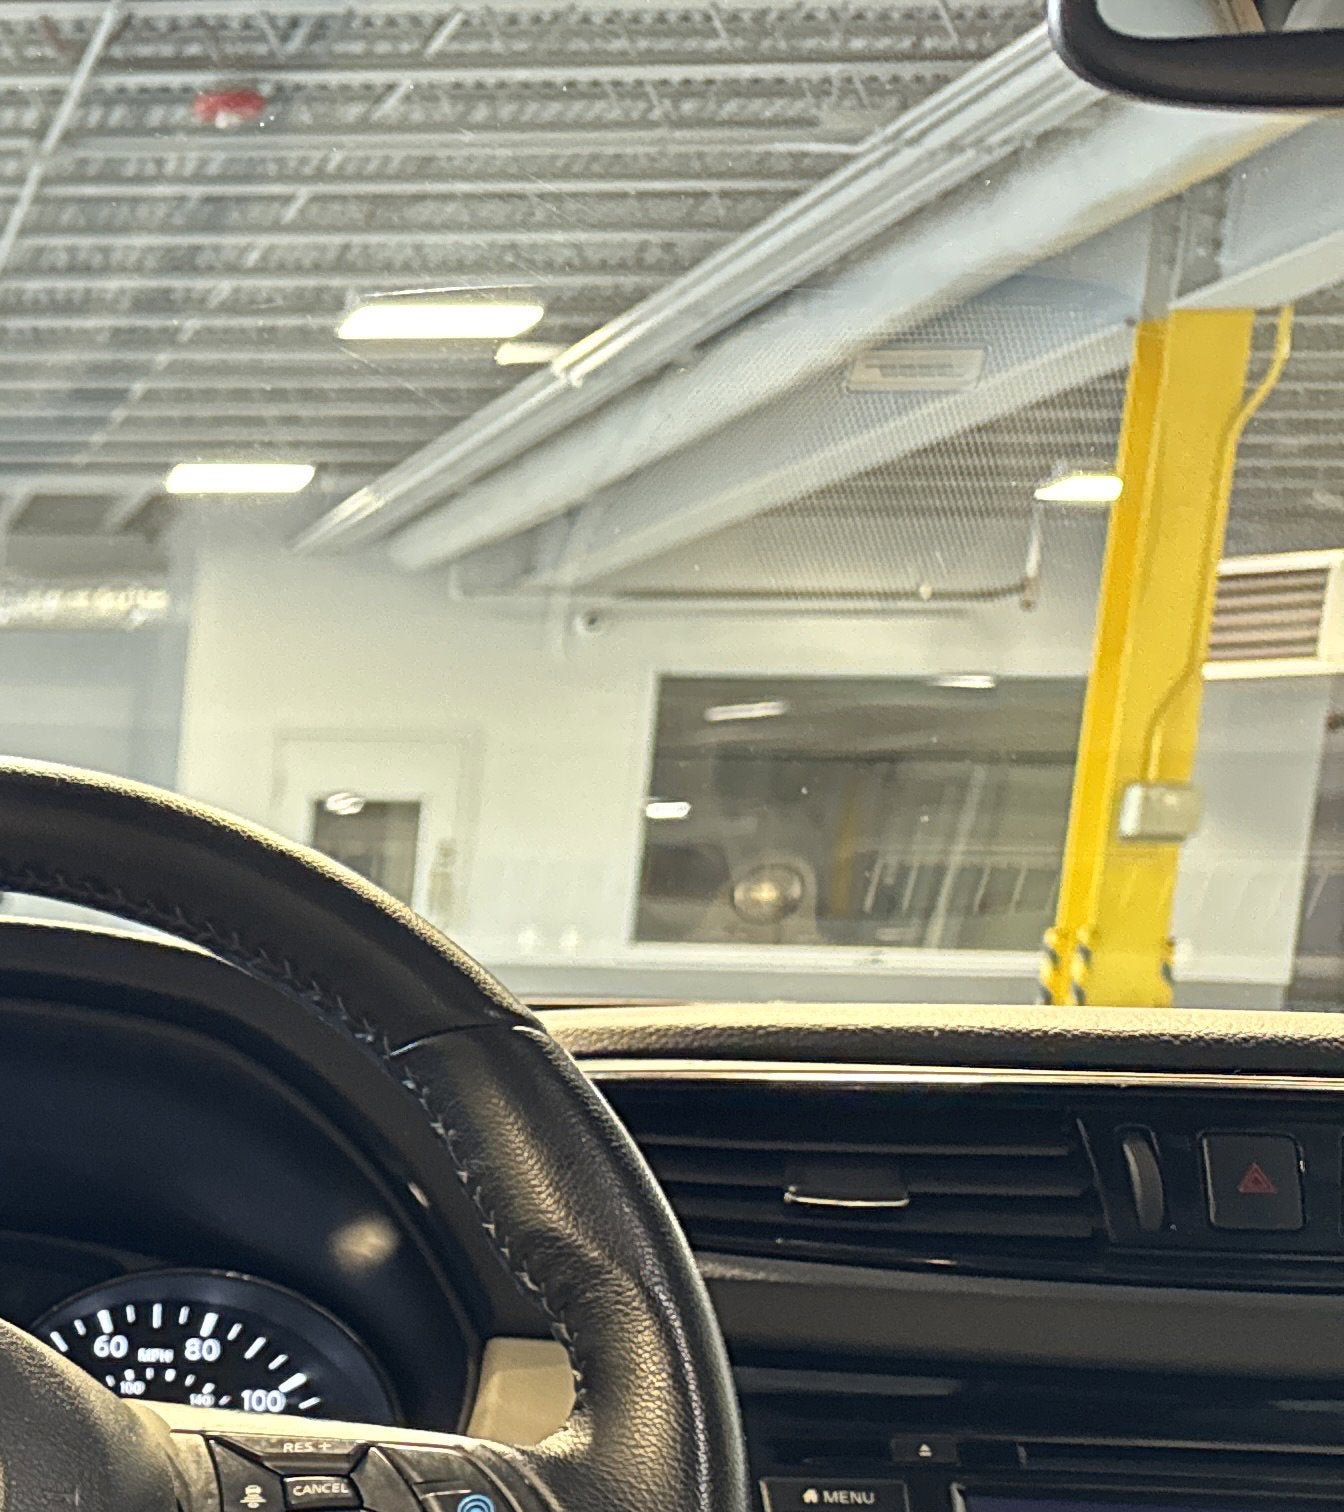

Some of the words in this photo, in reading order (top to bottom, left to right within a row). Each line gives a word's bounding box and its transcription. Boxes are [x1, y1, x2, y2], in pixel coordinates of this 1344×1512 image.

[93, 1335, 128, 1359] 60
[185, 1338, 221, 1361] 80
[138, 1348, 174, 1363] MPH
[120, 1381, 146, 1395] 100
[189, 1393, 216, 1407] 140
[241, 1389, 286, 1412] 100
[283, 1441, 312, 1454] RES
[293, 1482, 350, 1496] CANCEL
[823, 1489, 875, 1505] MENU
